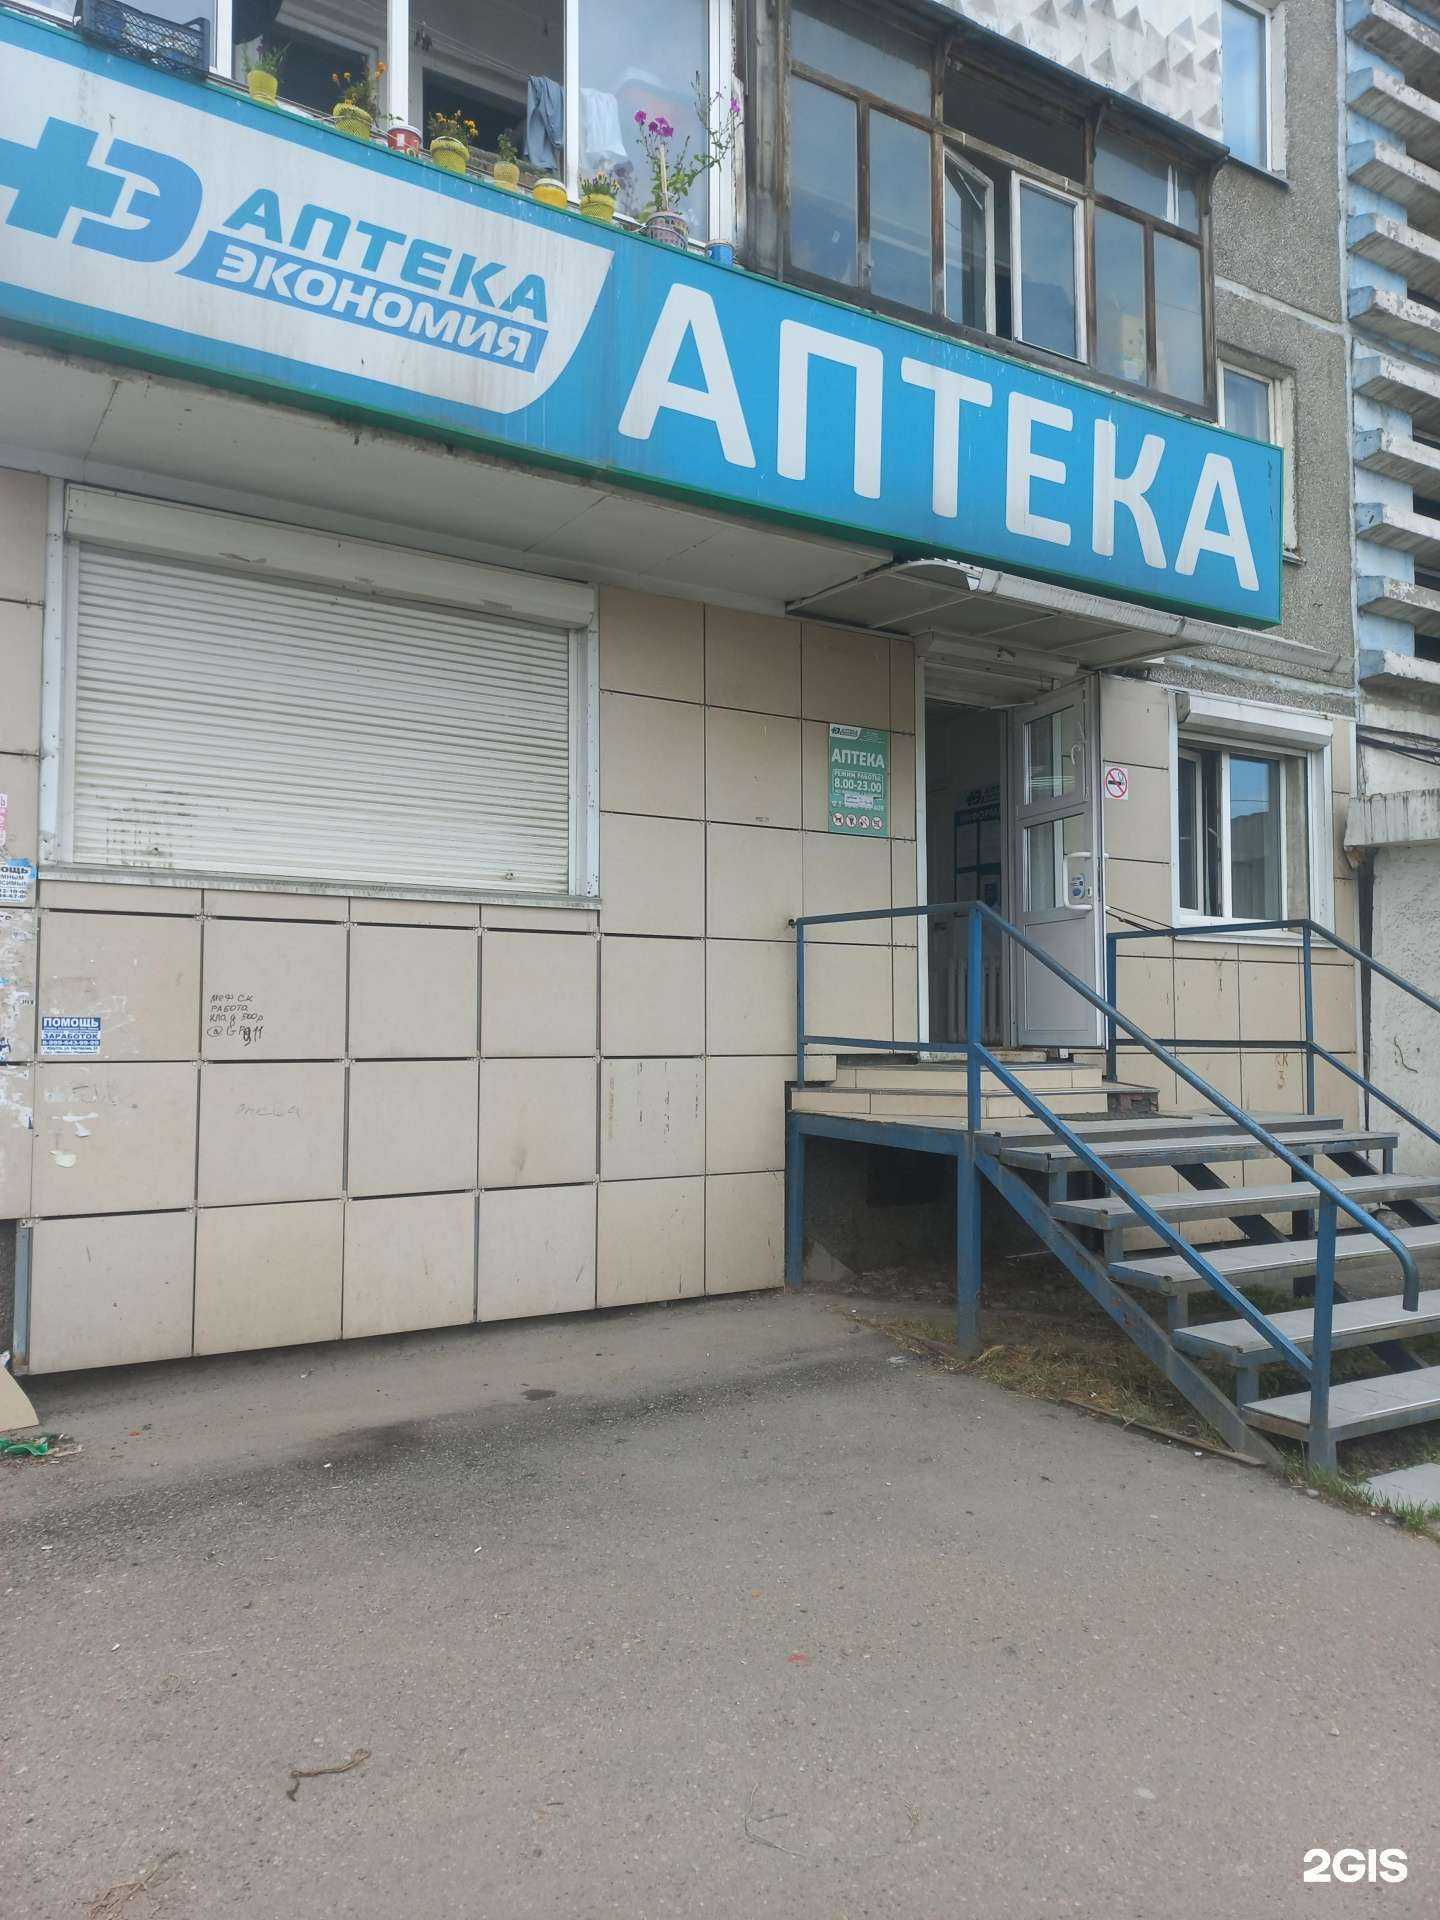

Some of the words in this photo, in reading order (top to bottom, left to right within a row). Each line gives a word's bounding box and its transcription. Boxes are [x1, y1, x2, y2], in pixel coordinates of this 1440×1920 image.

[223, 187, 548, 323] АПТЕКА
[215, 247, 532, 365] ЭКОНОМИЯ
[618, 282, 1259, 592] АПТЕКА
[832, 748, 885, 768] АПТЕКА
[834, 777, 881, 793] 8.00-23.00
[43, 1017, 99, 1028] ПОМОЩЬ
